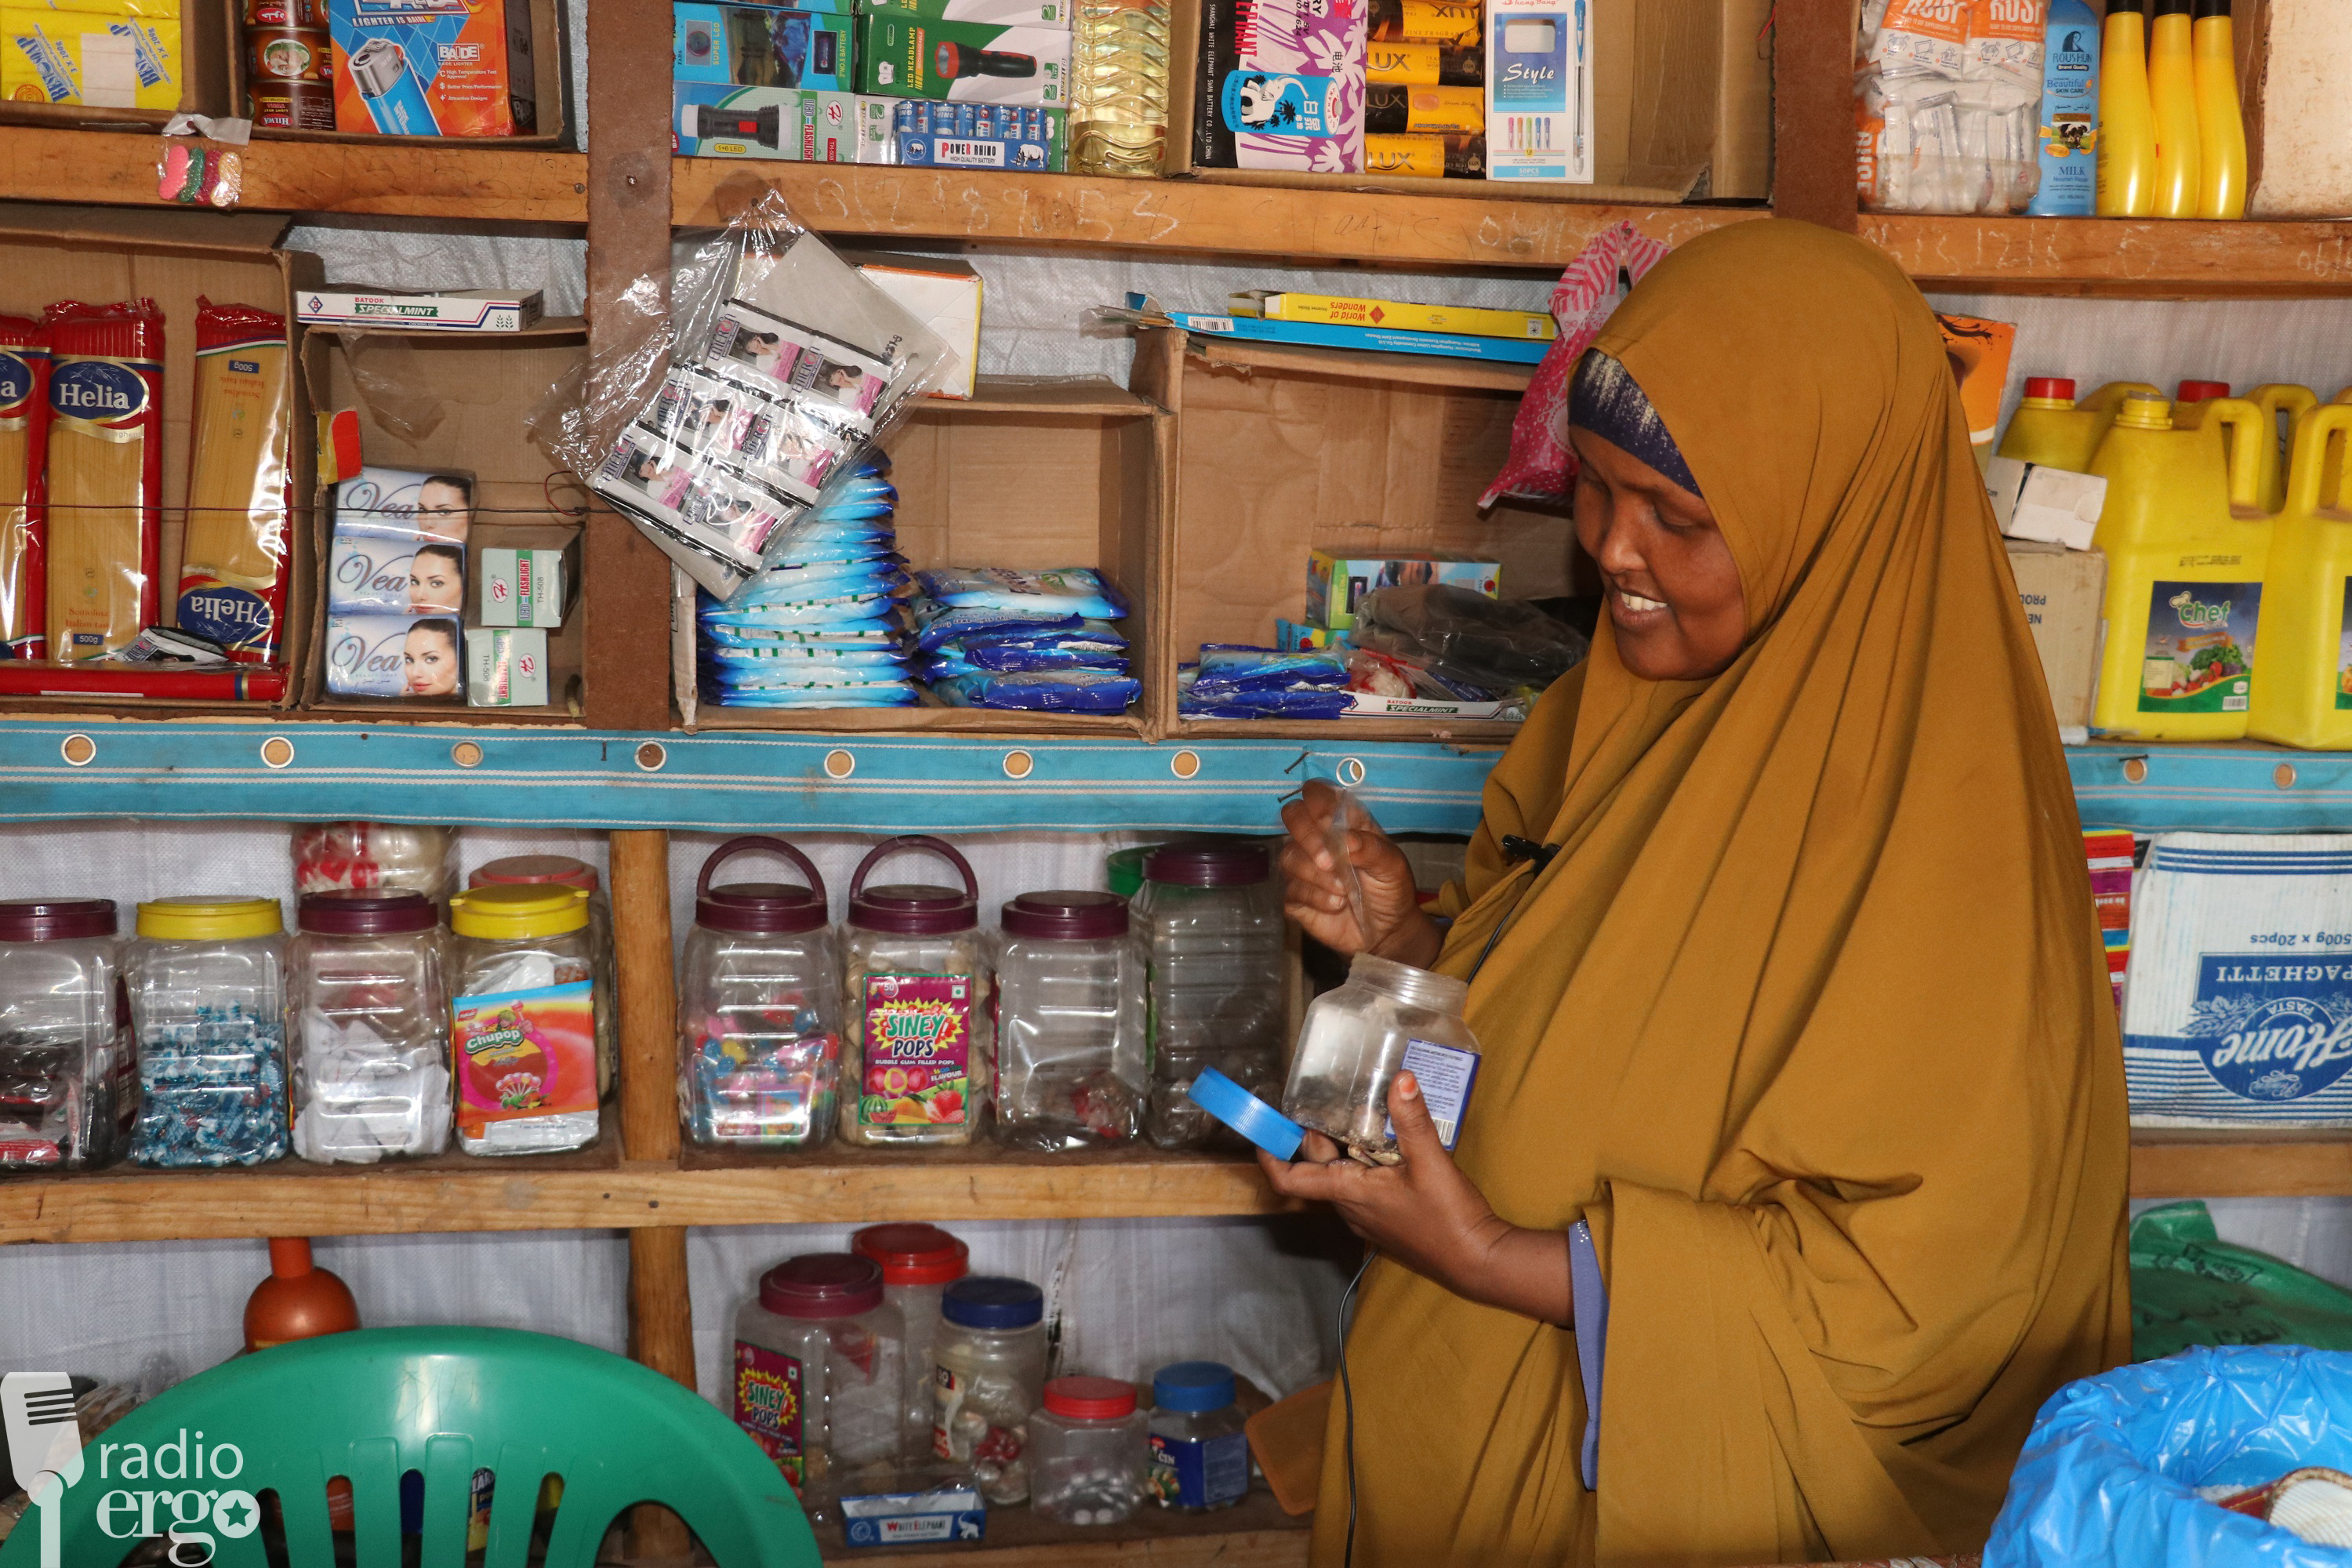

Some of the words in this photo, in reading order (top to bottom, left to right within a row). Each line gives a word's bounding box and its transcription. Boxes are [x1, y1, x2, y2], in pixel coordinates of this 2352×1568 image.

[1436, 5, 1475, 19] LUX
[353, 16, 394, 27] LIGHTER
[397, 16, 405, 24] IS
[1234, 0, 1258, 56] EPHANT
[147, 27, 162, 45] 200g
[16, 38, 45, 65] SOAP
[55, 41, 69, 59] 200g
[1332, 51, 1344, 74] 电池
[1502, 63, 1555, 85] Style
[42, 72, 71, 103] BEST
[2046, 78, 2085, 88] Beautiful
[263, 117, 289, 125] HILWA
[942, 142, 971, 158] POWER
[974, 143, 996, 157] RHINO
[1367, 152, 1415, 170] LUX
[2059, 166, 2085, 176] MILK
[1330, 302, 1367, 313] Wonders
[1330, 310, 1339, 320] of
[1341, 310, 1366, 321] World
[234, 360, 254, 372] 500g
[792, 346, 821, 395] EMERON
[60, 383, 131, 410] Helia
[346, 481, 422, 520] Vea
[337, 554, 413, 593] Vea
[536, 576, 545, 602] TH-508
[68, 608, 108, 617] Semolina
[191, 595, 257, 624] Helia
[65, 619, 93, 628] Italian
[79, 636, 98, 644] 500g
[332, 633, 407, 675] Vea
[2250, 932, 2297, 946] 20pcs
[2302, 935, 2310, 943] x
[2316, 932, 2352, 946] 500g
[2216, 965, 2352, 982] PAGHETTI
[2267, 1001, 2315, 1016] PASTA
[466, 1029, 521, 1048] Chupop
[2212, 1021, 2352, 1072] Home
[891, 1039, 934, 1057] POPS
[931, 1070, 963, 1082] FLAVOUR
[751, 1406, 780, 1428] POPS
